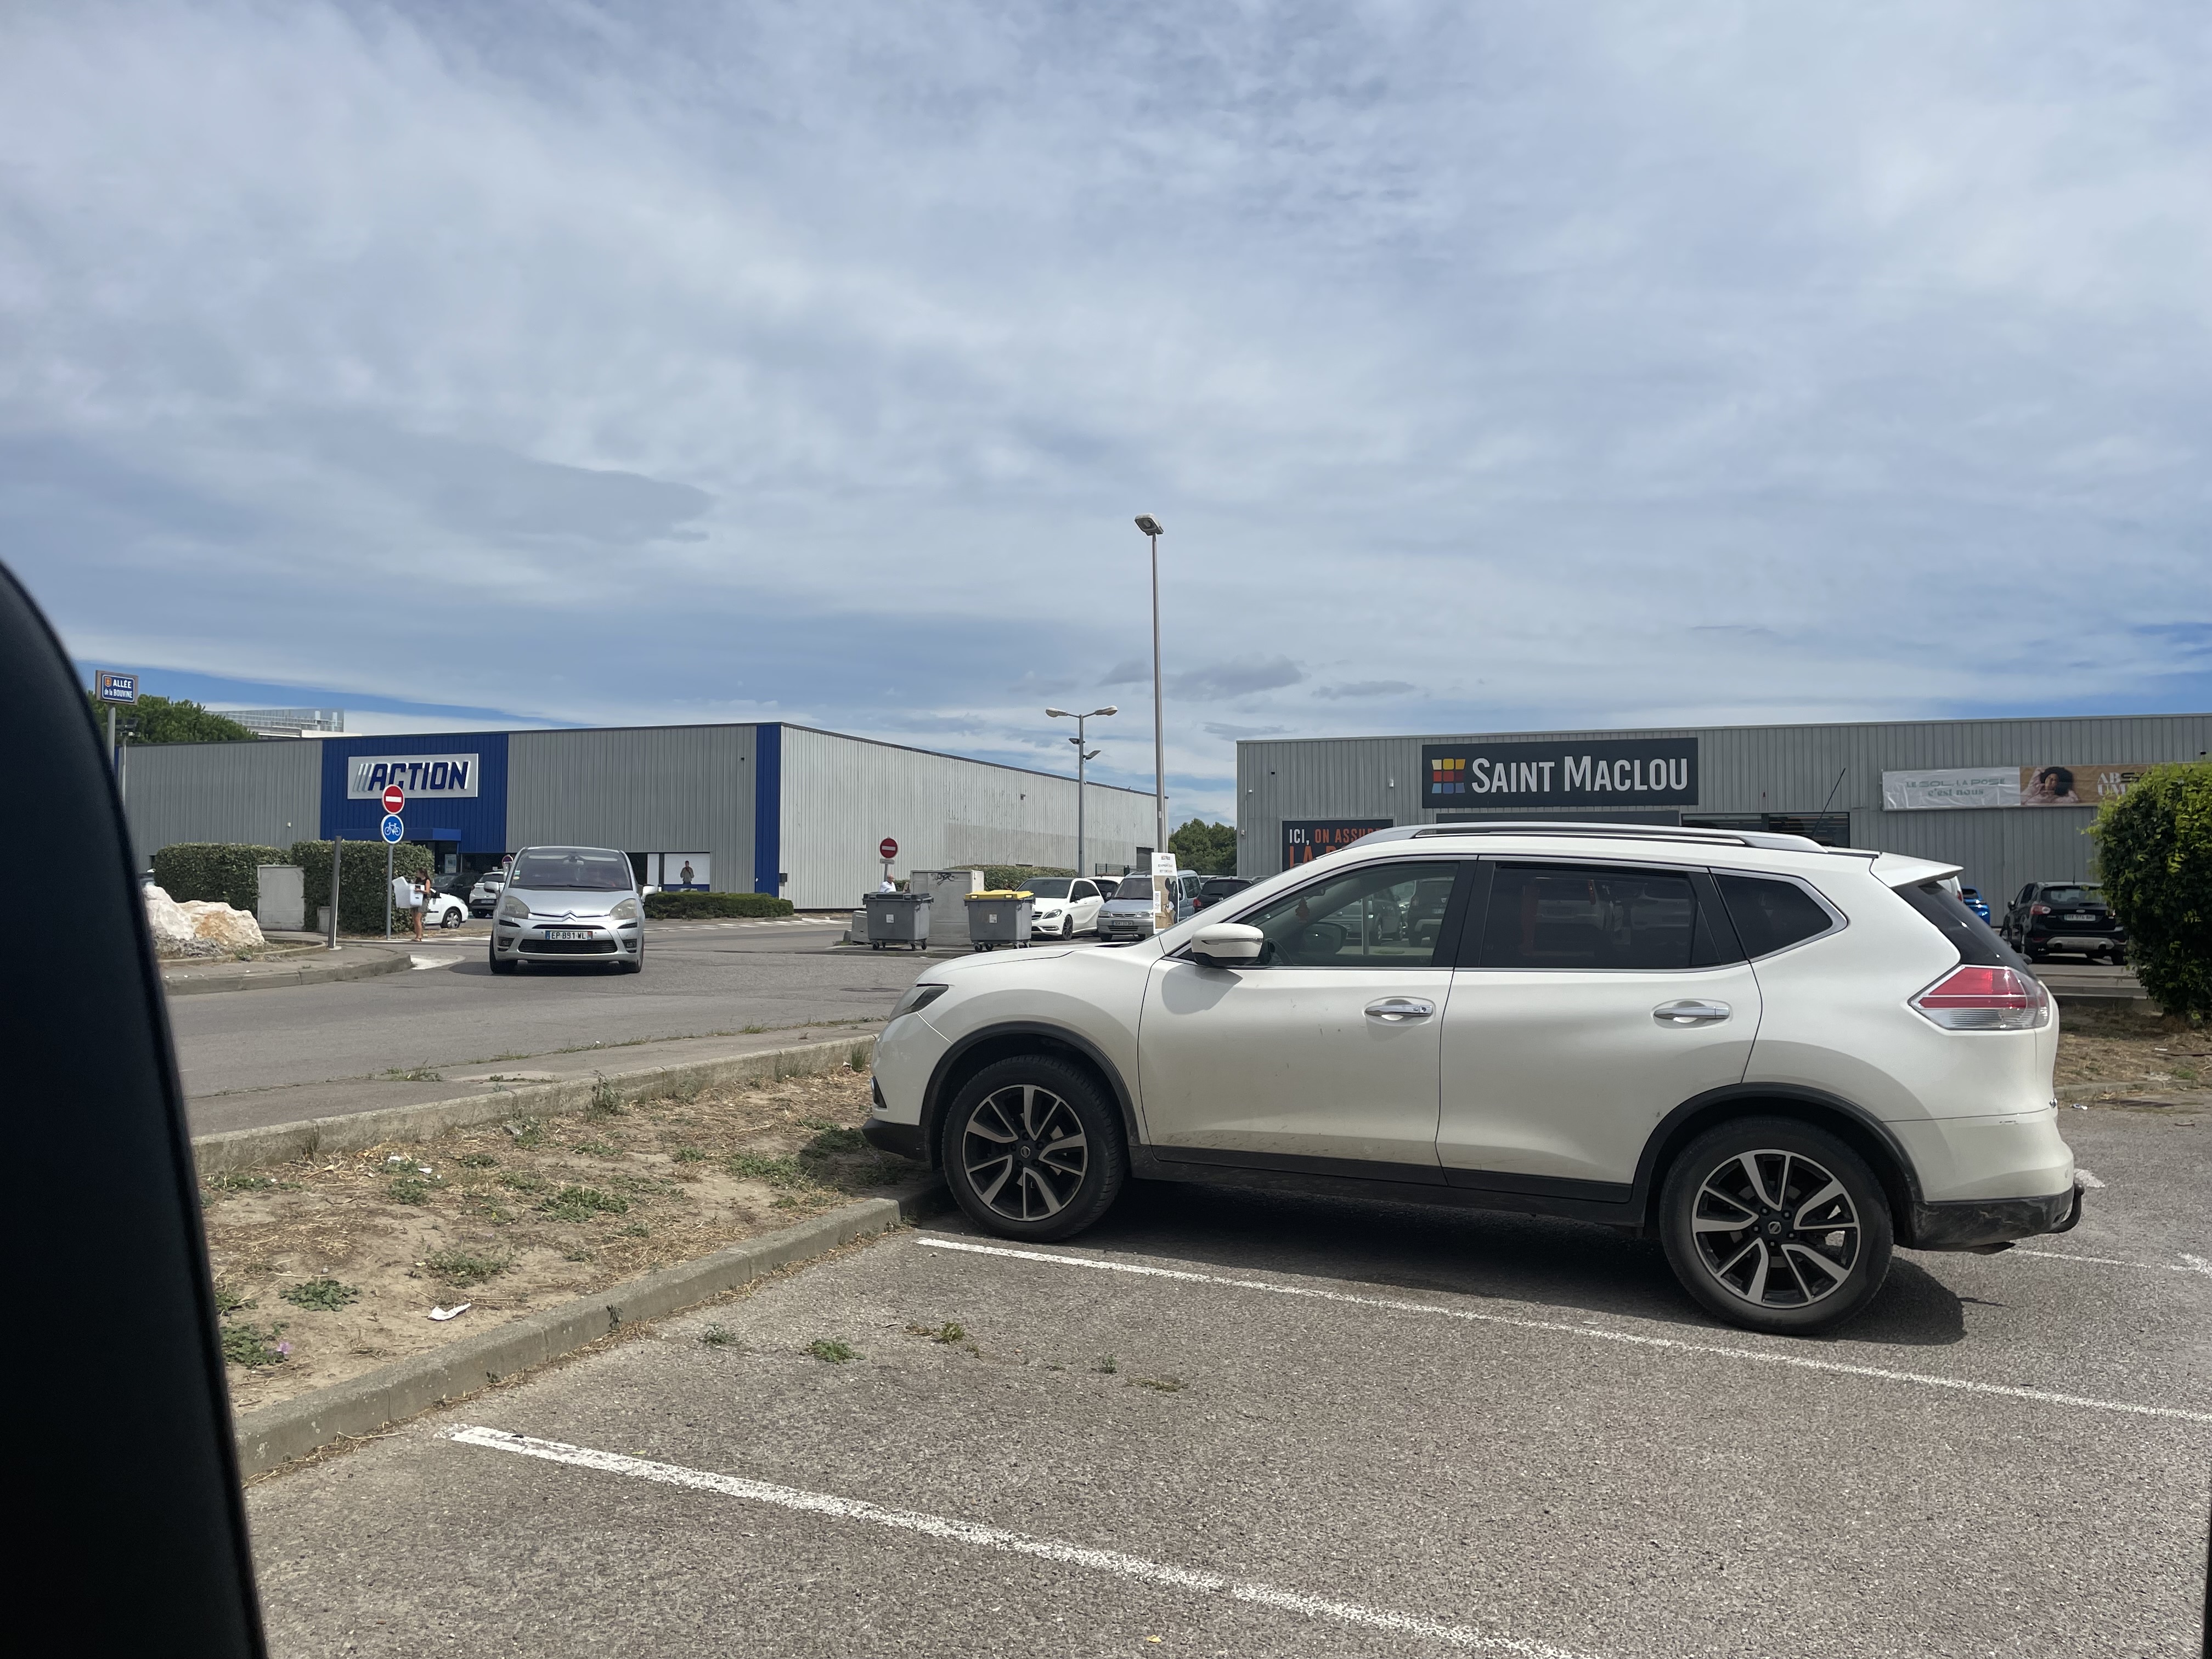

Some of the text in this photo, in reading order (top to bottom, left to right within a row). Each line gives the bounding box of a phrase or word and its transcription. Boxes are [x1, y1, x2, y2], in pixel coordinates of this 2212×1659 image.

[113, 679, 132, 689] ALLÉE
[368, 760, 470, 791] ACTION
[1472, 755, 1688, 793] SAINT MACLOU
[1289, 828, 1382, 845] ICI, ON ASSU
